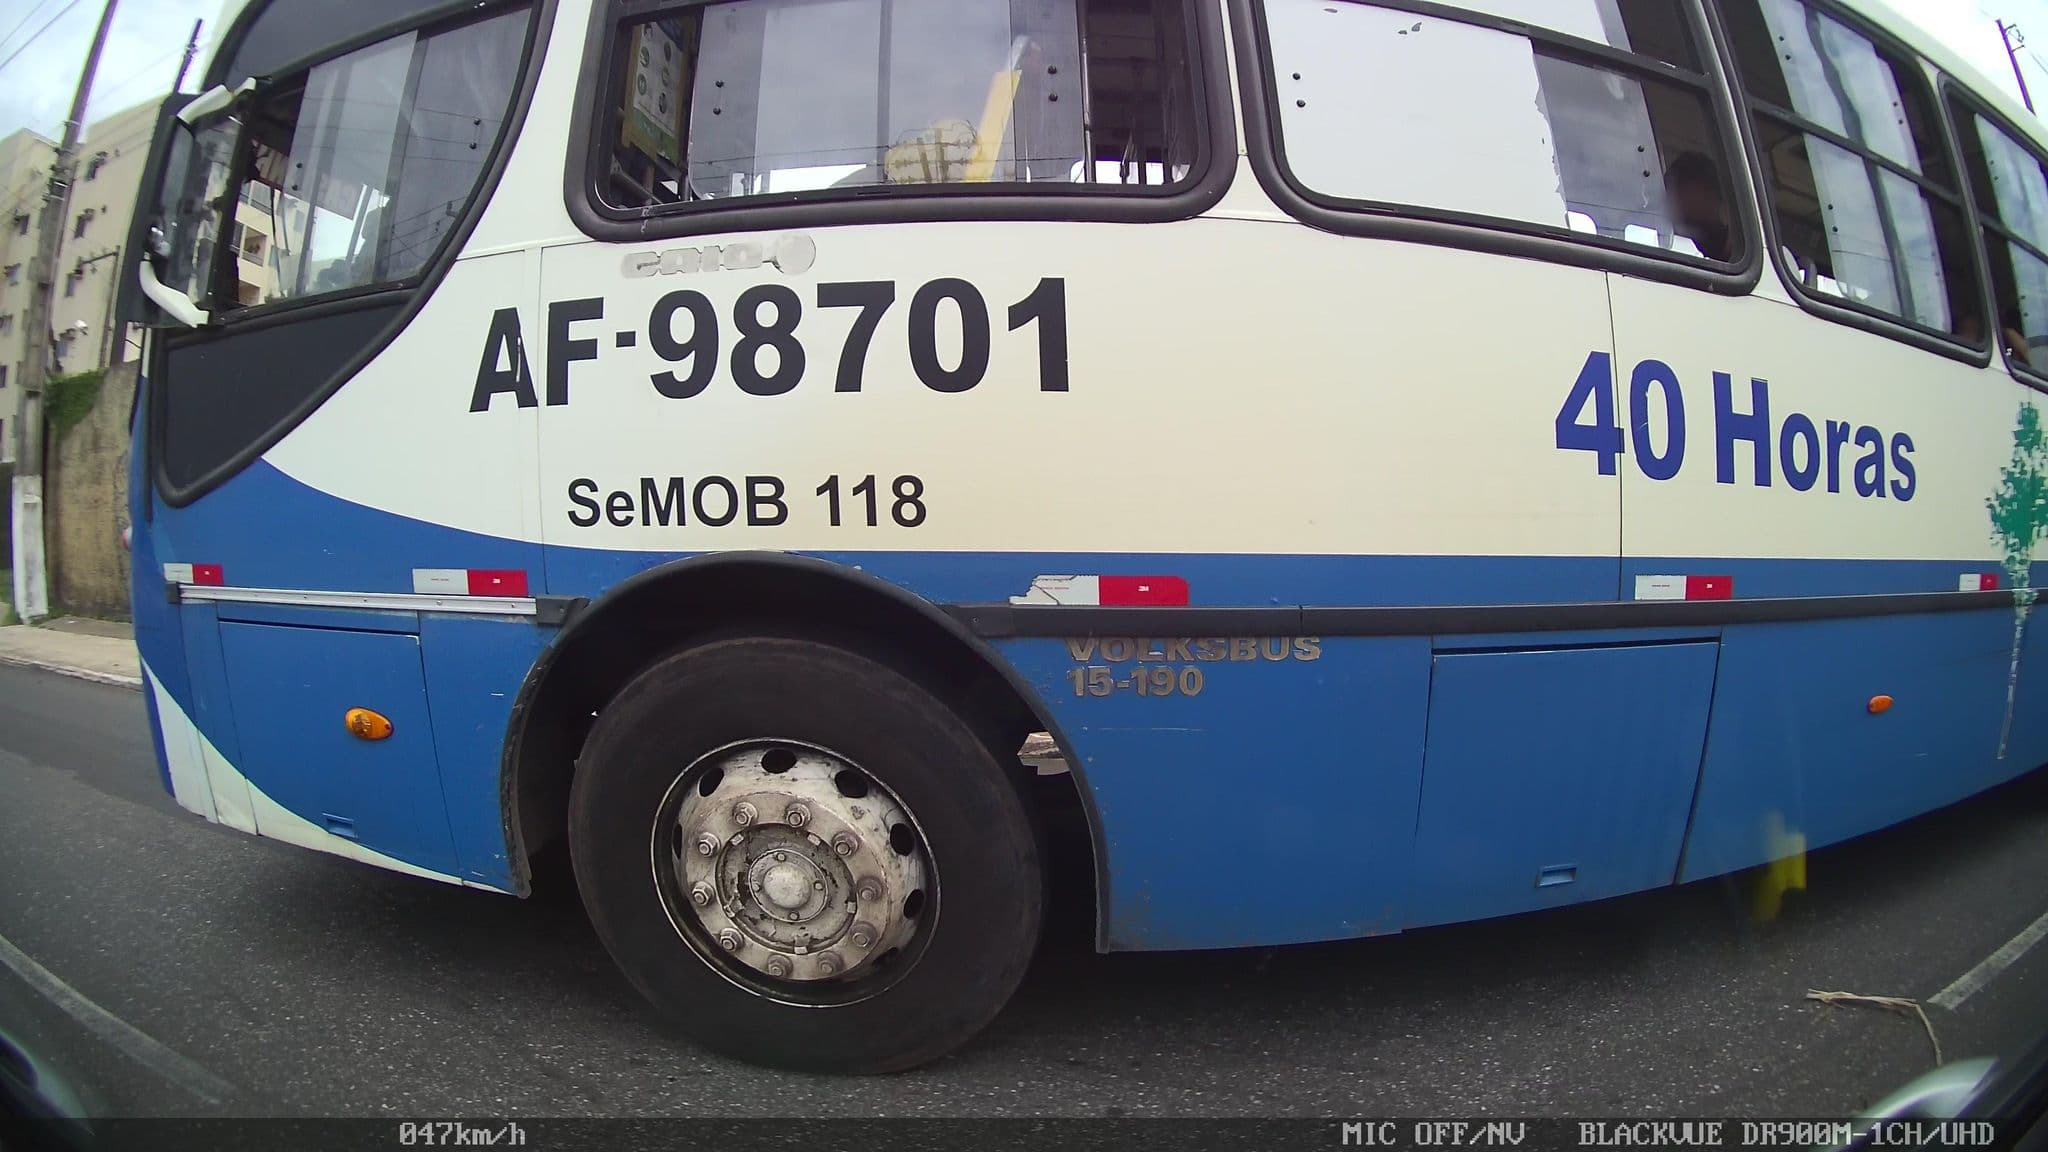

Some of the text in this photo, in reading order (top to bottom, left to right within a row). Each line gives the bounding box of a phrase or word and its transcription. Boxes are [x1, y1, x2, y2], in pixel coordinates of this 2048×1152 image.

[469, 277, 1069, 412] AF-98701
[1555, 351, 1917, 502] 40 Horas
[567, 474, 927, 528] SeMOB 118
[1066, 636, 1322, 662] VOLKSBUS
[1066, 665, 1204, 698] 15-190
